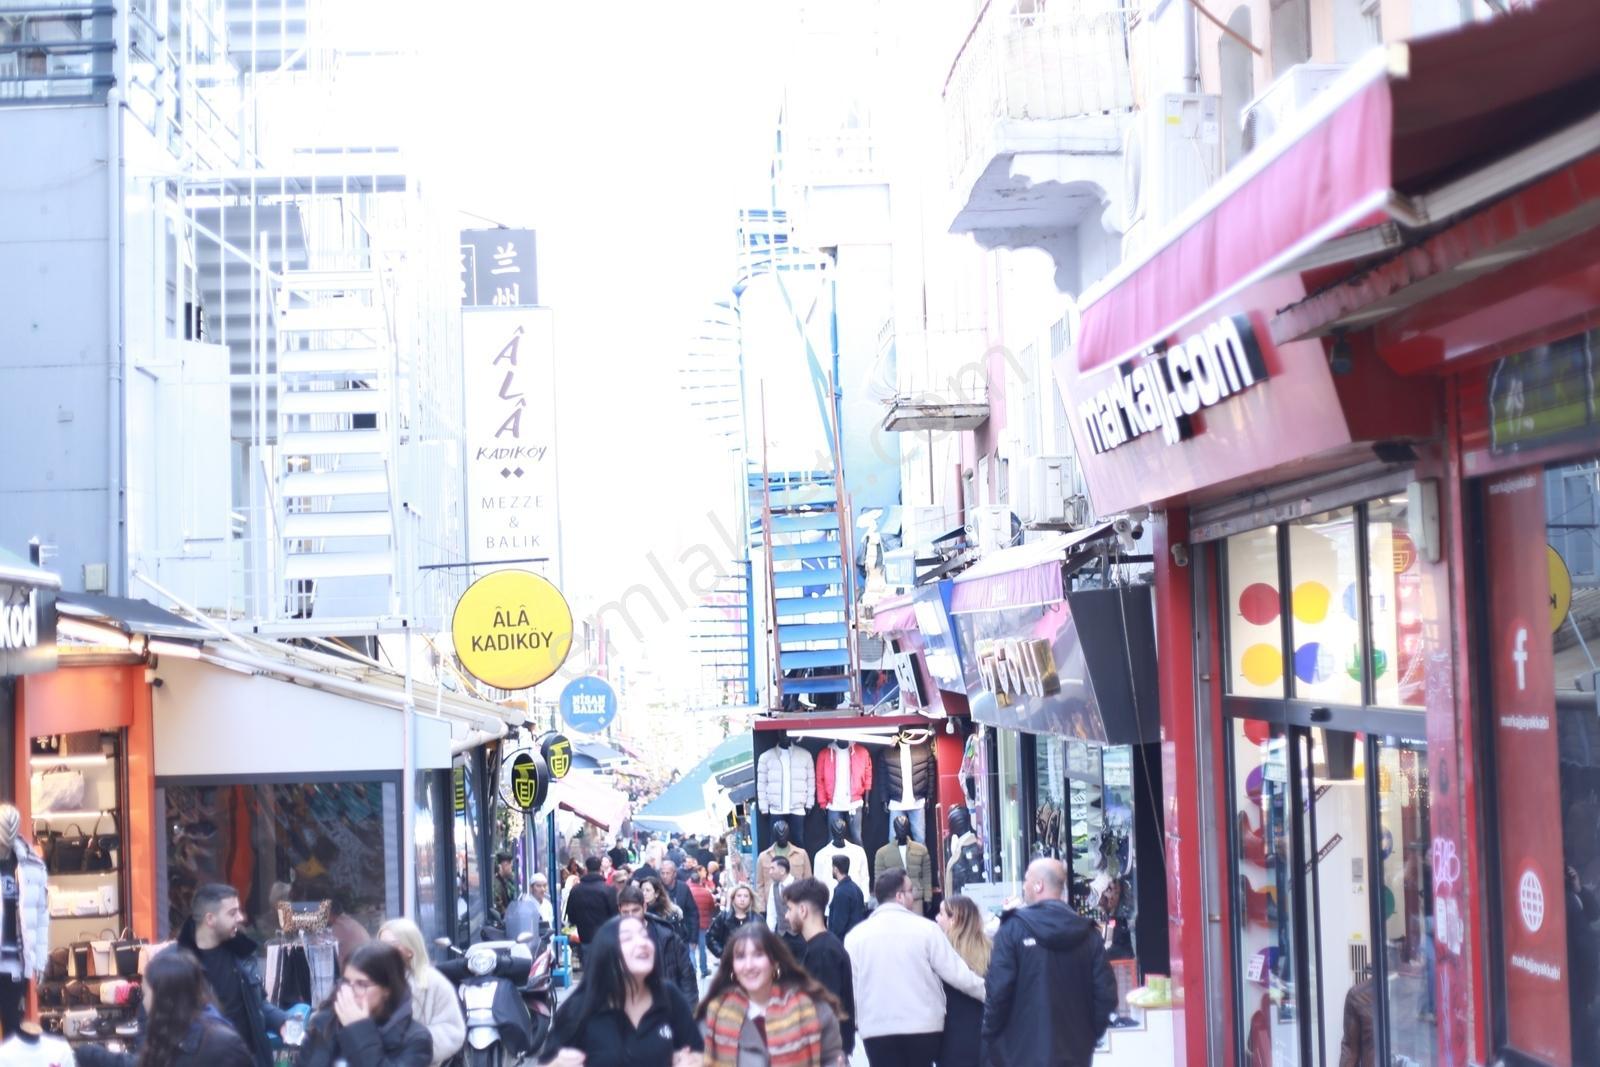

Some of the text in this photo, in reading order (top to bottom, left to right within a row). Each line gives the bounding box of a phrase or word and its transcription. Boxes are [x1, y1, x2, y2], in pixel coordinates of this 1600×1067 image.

[481, 495, 544, 510] MEZZE
[508, 515, 520, 529] &
[486, 535, 541, 549] BALIK
[493, 604, 530, 628] ÂLÂ
[471, 627, 553, 652] KADIKÖY
